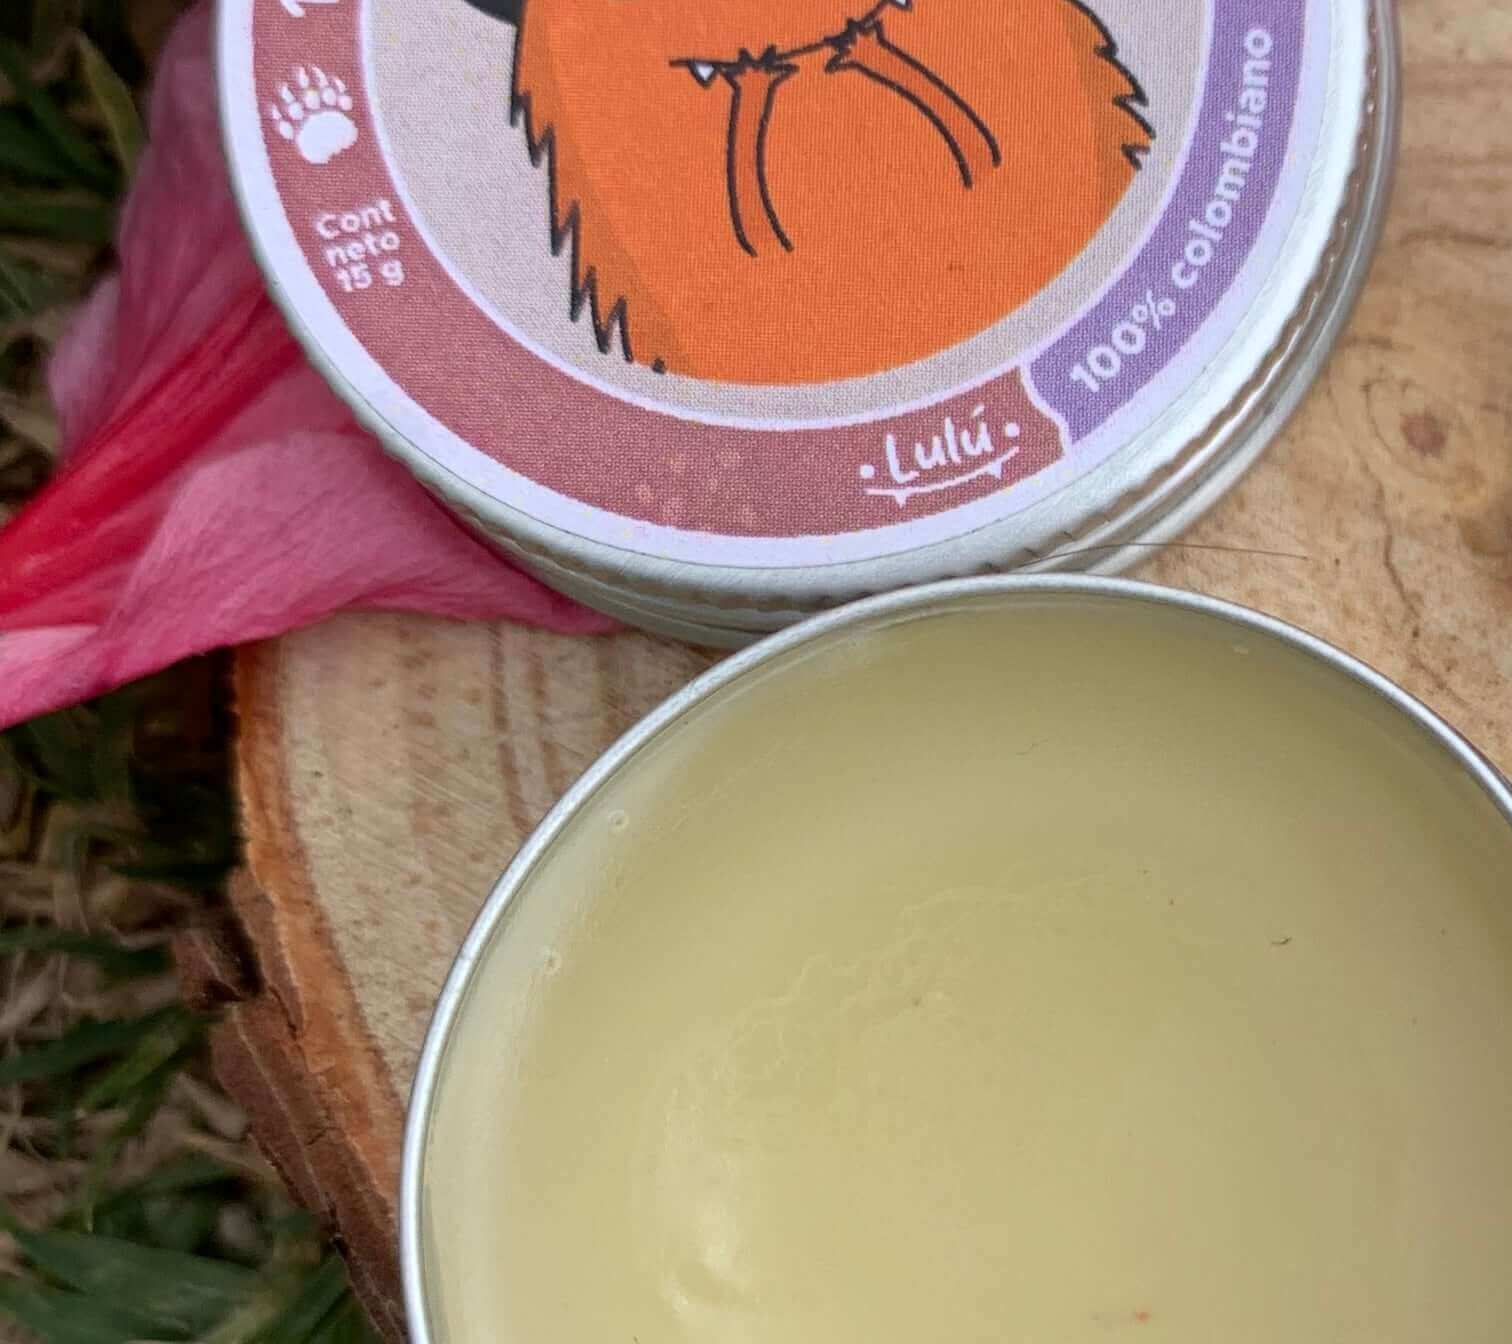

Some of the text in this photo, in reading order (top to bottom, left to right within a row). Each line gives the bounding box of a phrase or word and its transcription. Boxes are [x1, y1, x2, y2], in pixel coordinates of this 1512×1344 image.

[316, 198, 396, 239] Cont
[1069, 27, 1275, 394] 100% colombiano
[325, 233, 401, 268] neto
[336, 260, 406, 293] 15 g
